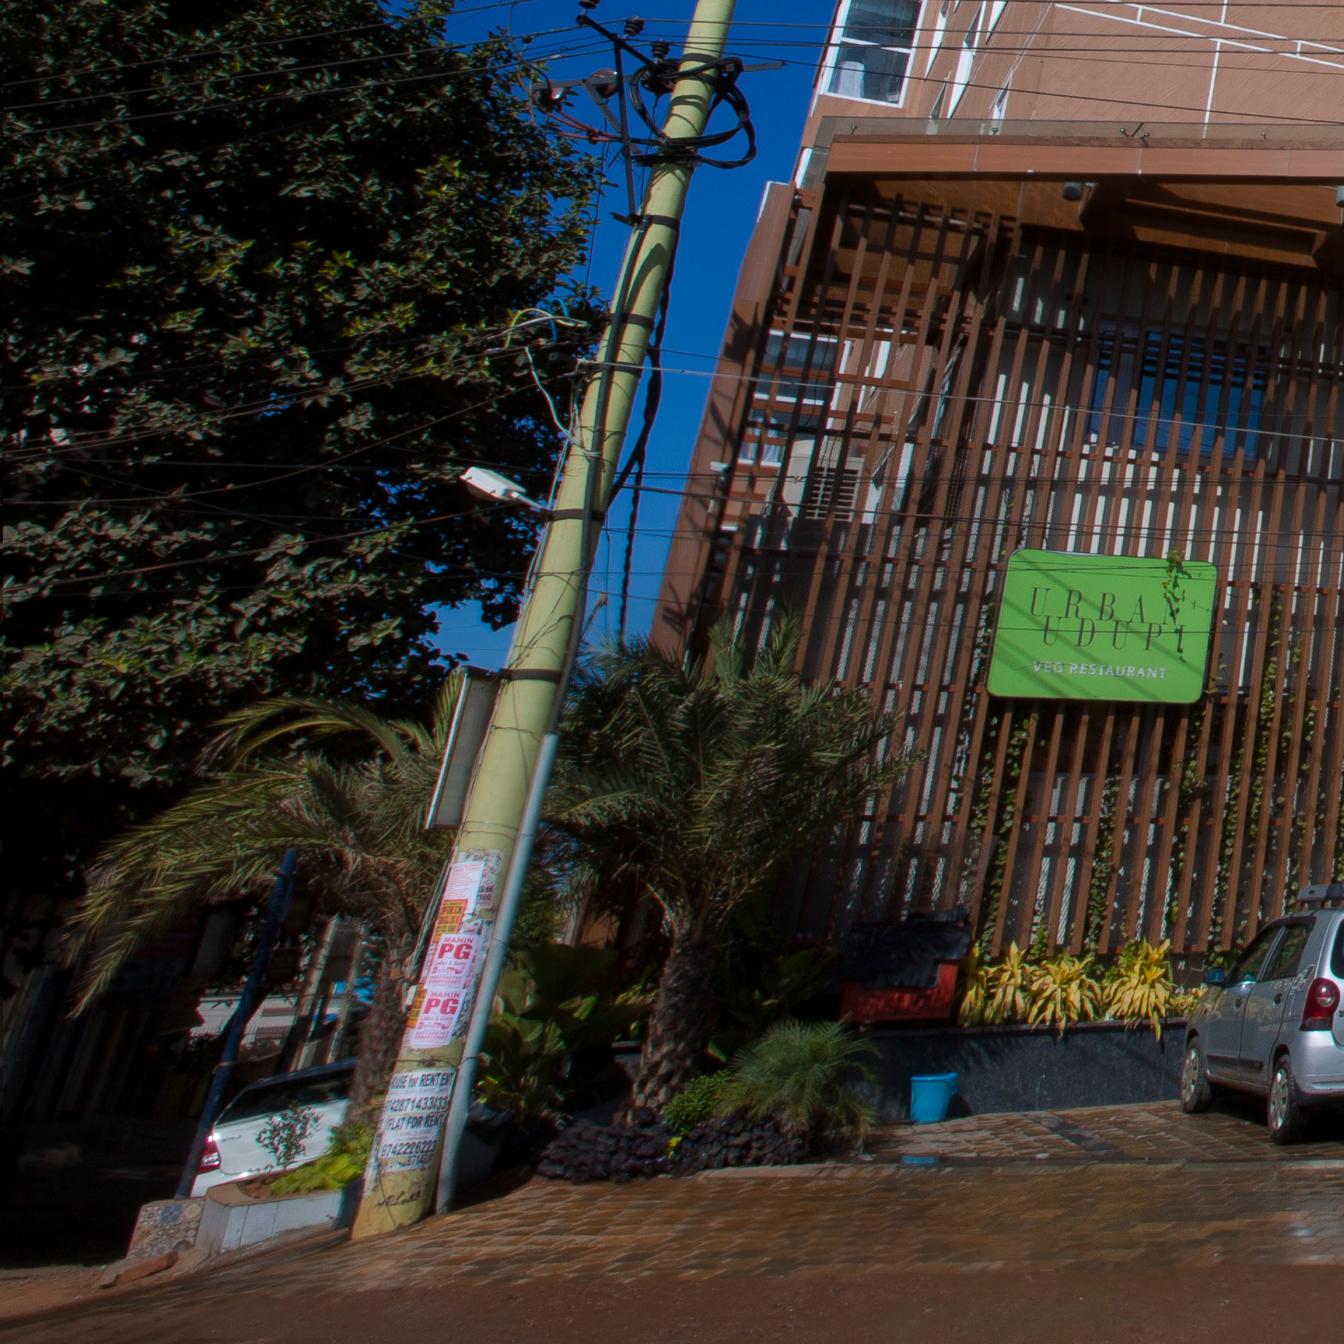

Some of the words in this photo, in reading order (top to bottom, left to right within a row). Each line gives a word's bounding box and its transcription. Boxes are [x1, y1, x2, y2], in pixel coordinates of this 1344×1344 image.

[1030, 586, 1185, 626] URBAN
[1042, 615, 1186, 654] UDUPI
[1032, 660, 1064, 674] VEG
[1068, 662, 1169, 679] RESTAURANT
[437, 943, 473, 960] PG
[423, 998, 460, 1014] PG
